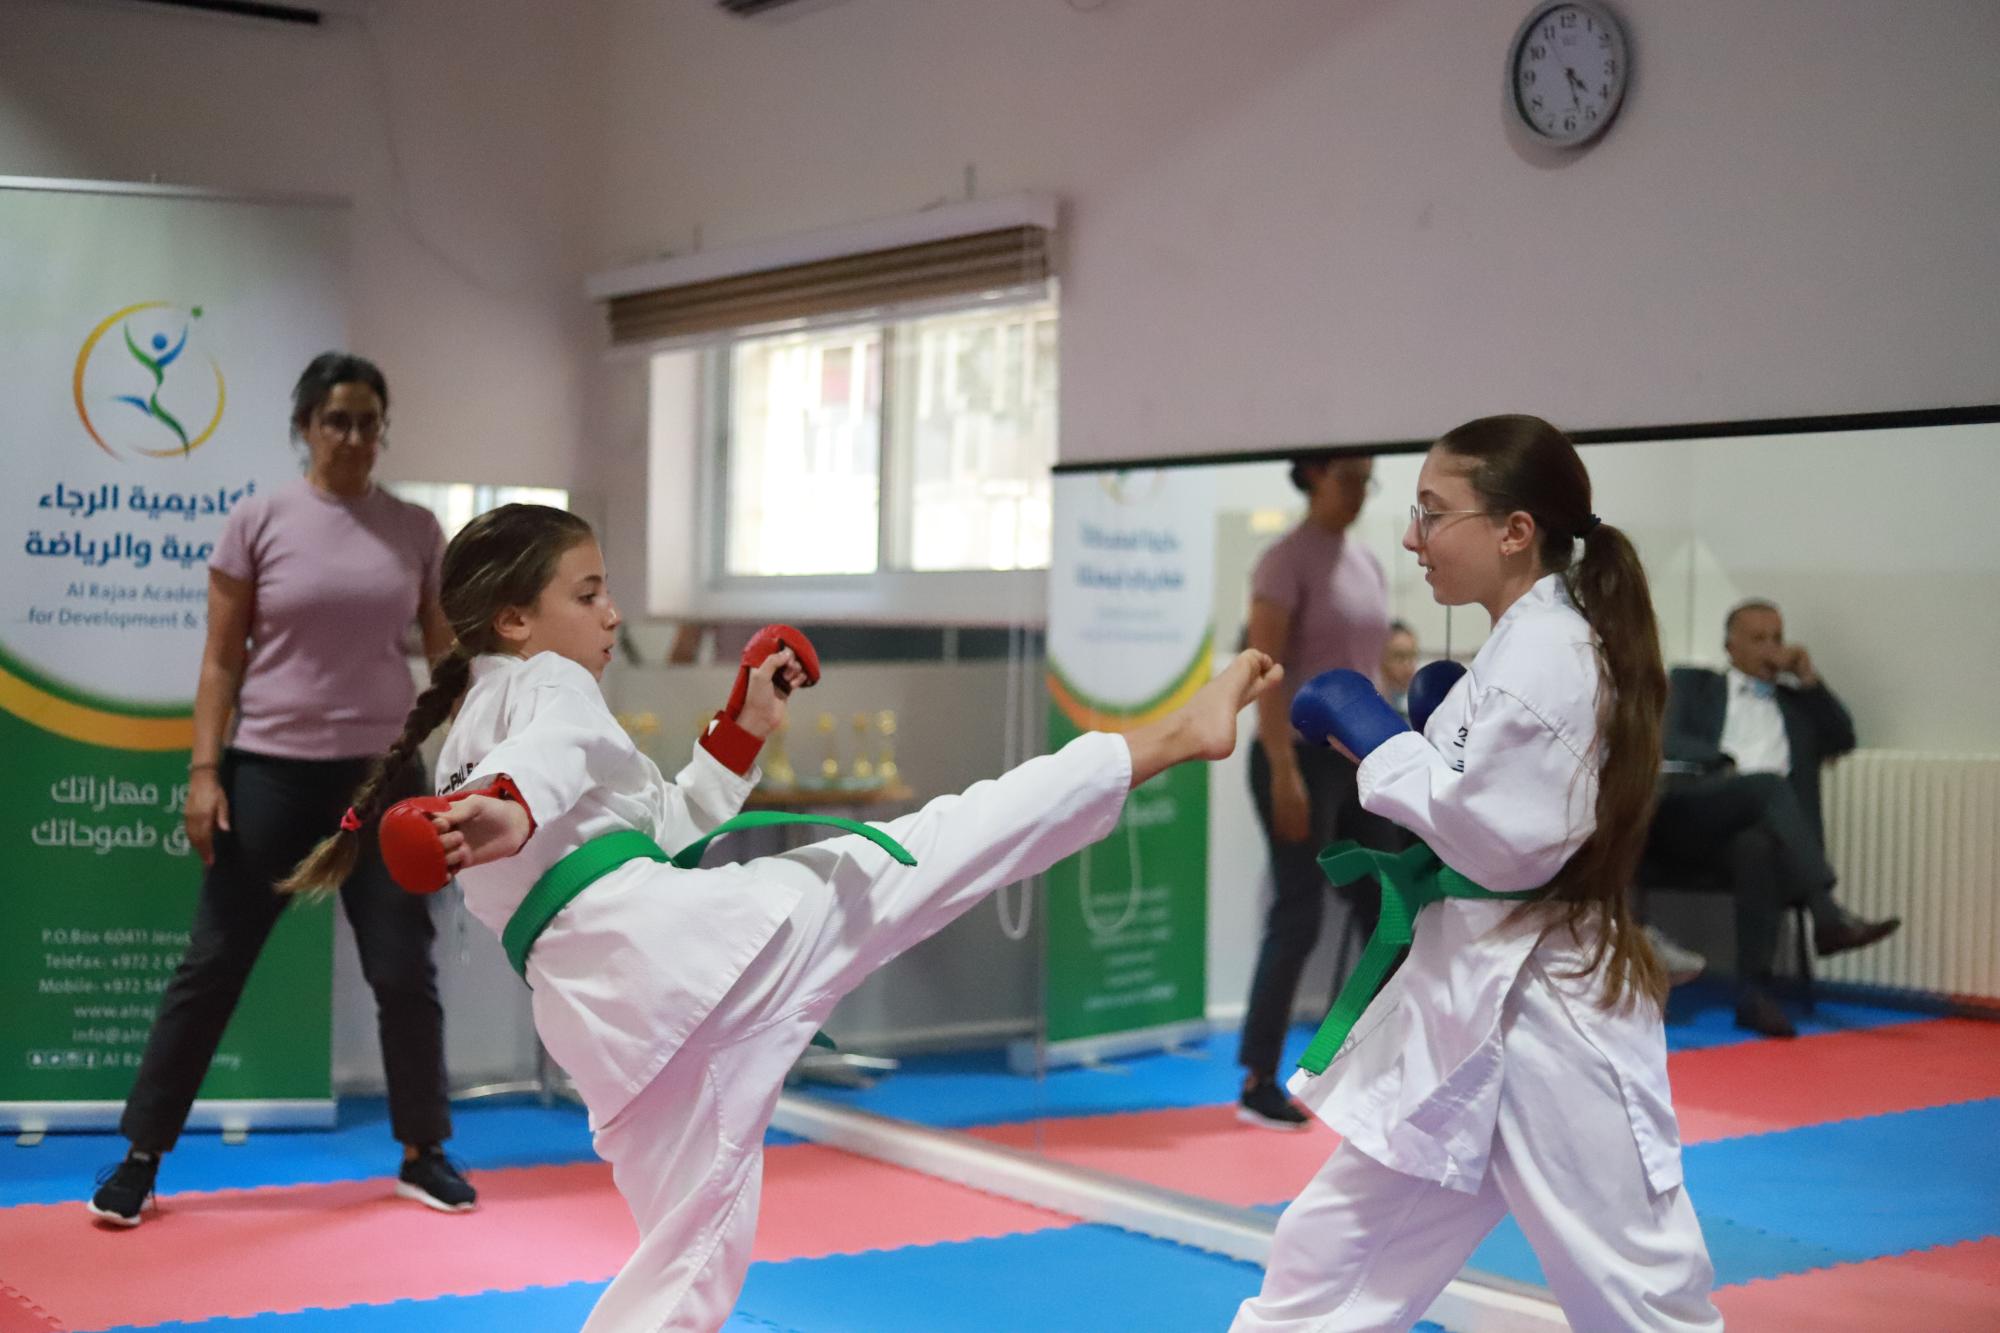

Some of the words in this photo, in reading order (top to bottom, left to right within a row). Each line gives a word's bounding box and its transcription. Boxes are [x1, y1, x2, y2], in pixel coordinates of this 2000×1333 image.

[1561, 12, 1577, 28] 12
[1543, 25, 1556, 40] 11
[1530, 45, 1546, 60] 10
[38, 482, 119, 518] الرجاء
[25, 529, 152, 568] والرياضة
[66, 582, 84, 599] Al
[89, 582, 138, 604] Rajaa
[143, 582, 208, 601] Academ
[28, 608, 52, 626] for
[58, 608, 177, 630] Development
[183, 611, 197, 629] &
[51, 774, 158, 813] مهاراتك
[31, 817, 157, 855] طموحاتك
[152, 928, 192, 946] Jerus
[73, 1004, 156, 1021] www.alraj
